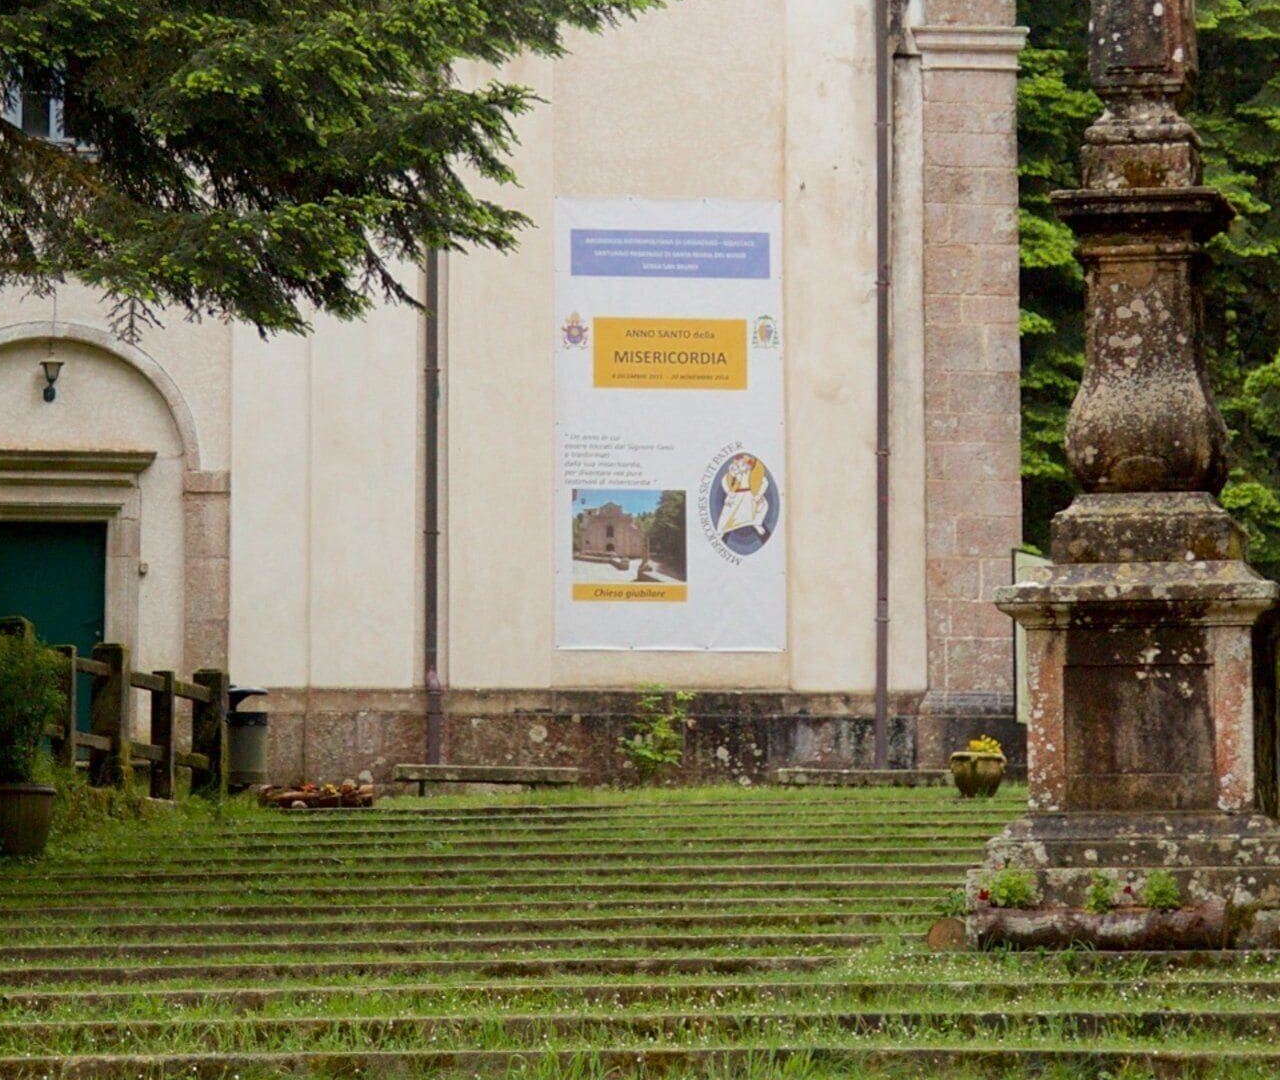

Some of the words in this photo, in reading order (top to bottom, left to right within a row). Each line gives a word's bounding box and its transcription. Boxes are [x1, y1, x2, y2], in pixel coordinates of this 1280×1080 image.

[625, 329, 656, 339] ANNO
[657, 330, 691, 339] SANTO
[693, 330, 716, 340] della
[614, 350, 728, 365] MISERICORDIA
[593, 588, 623, 598] Chiesa
[625, 588, 666, 599] giubilare
